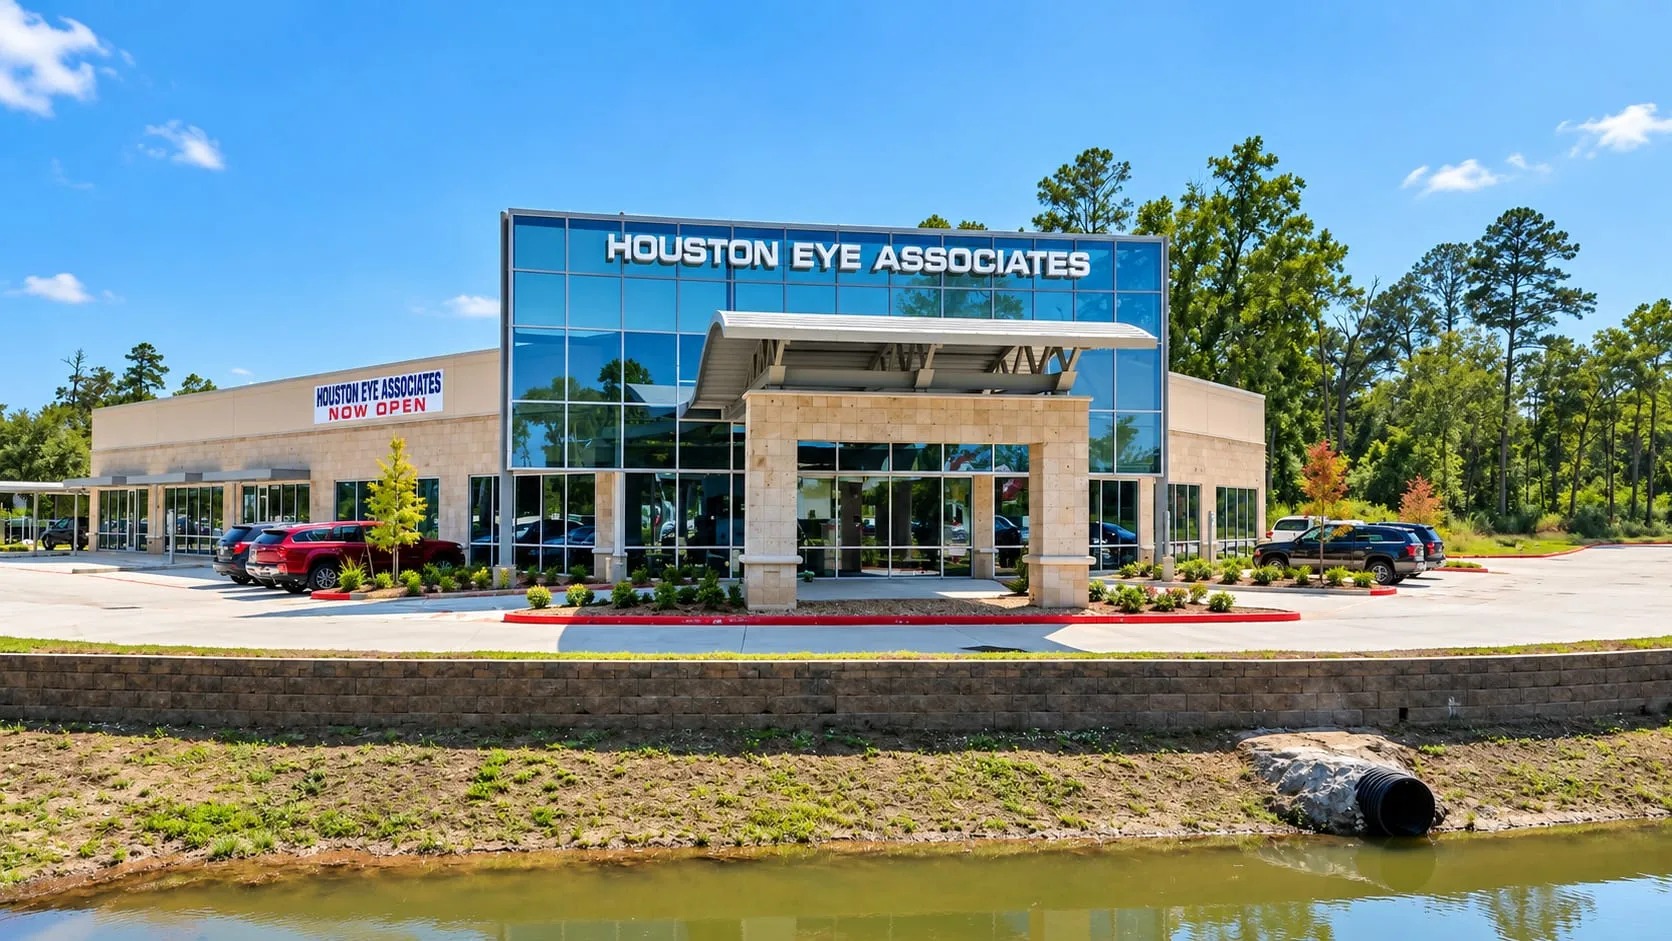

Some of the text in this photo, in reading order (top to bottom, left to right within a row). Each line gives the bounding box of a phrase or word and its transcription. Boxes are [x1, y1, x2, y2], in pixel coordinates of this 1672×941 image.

[607, 233, 1091, 277] HOUSTON EYE ASSOCIATES
[316, 371, 441, 407] HOUSTON EYE ASSOCIATES
[328, 397, 425, 420] NOW OPEN
